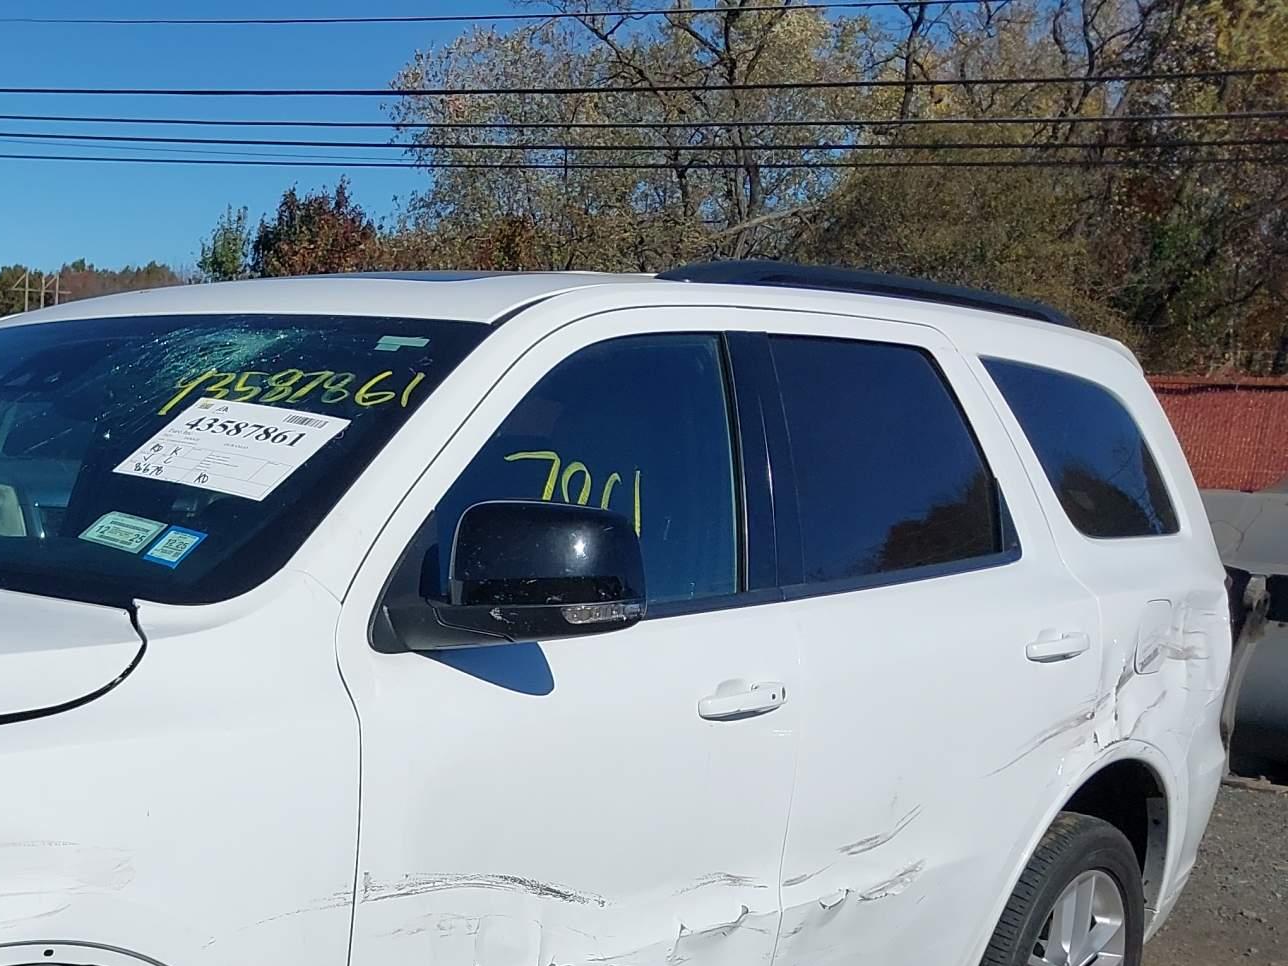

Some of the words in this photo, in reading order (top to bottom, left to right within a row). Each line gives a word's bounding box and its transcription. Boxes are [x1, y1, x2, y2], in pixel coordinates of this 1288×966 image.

[185, 416, 306, 448] 43587861
[95, 525, 111, 535] 12
[129, 533, 146, 544] 25
